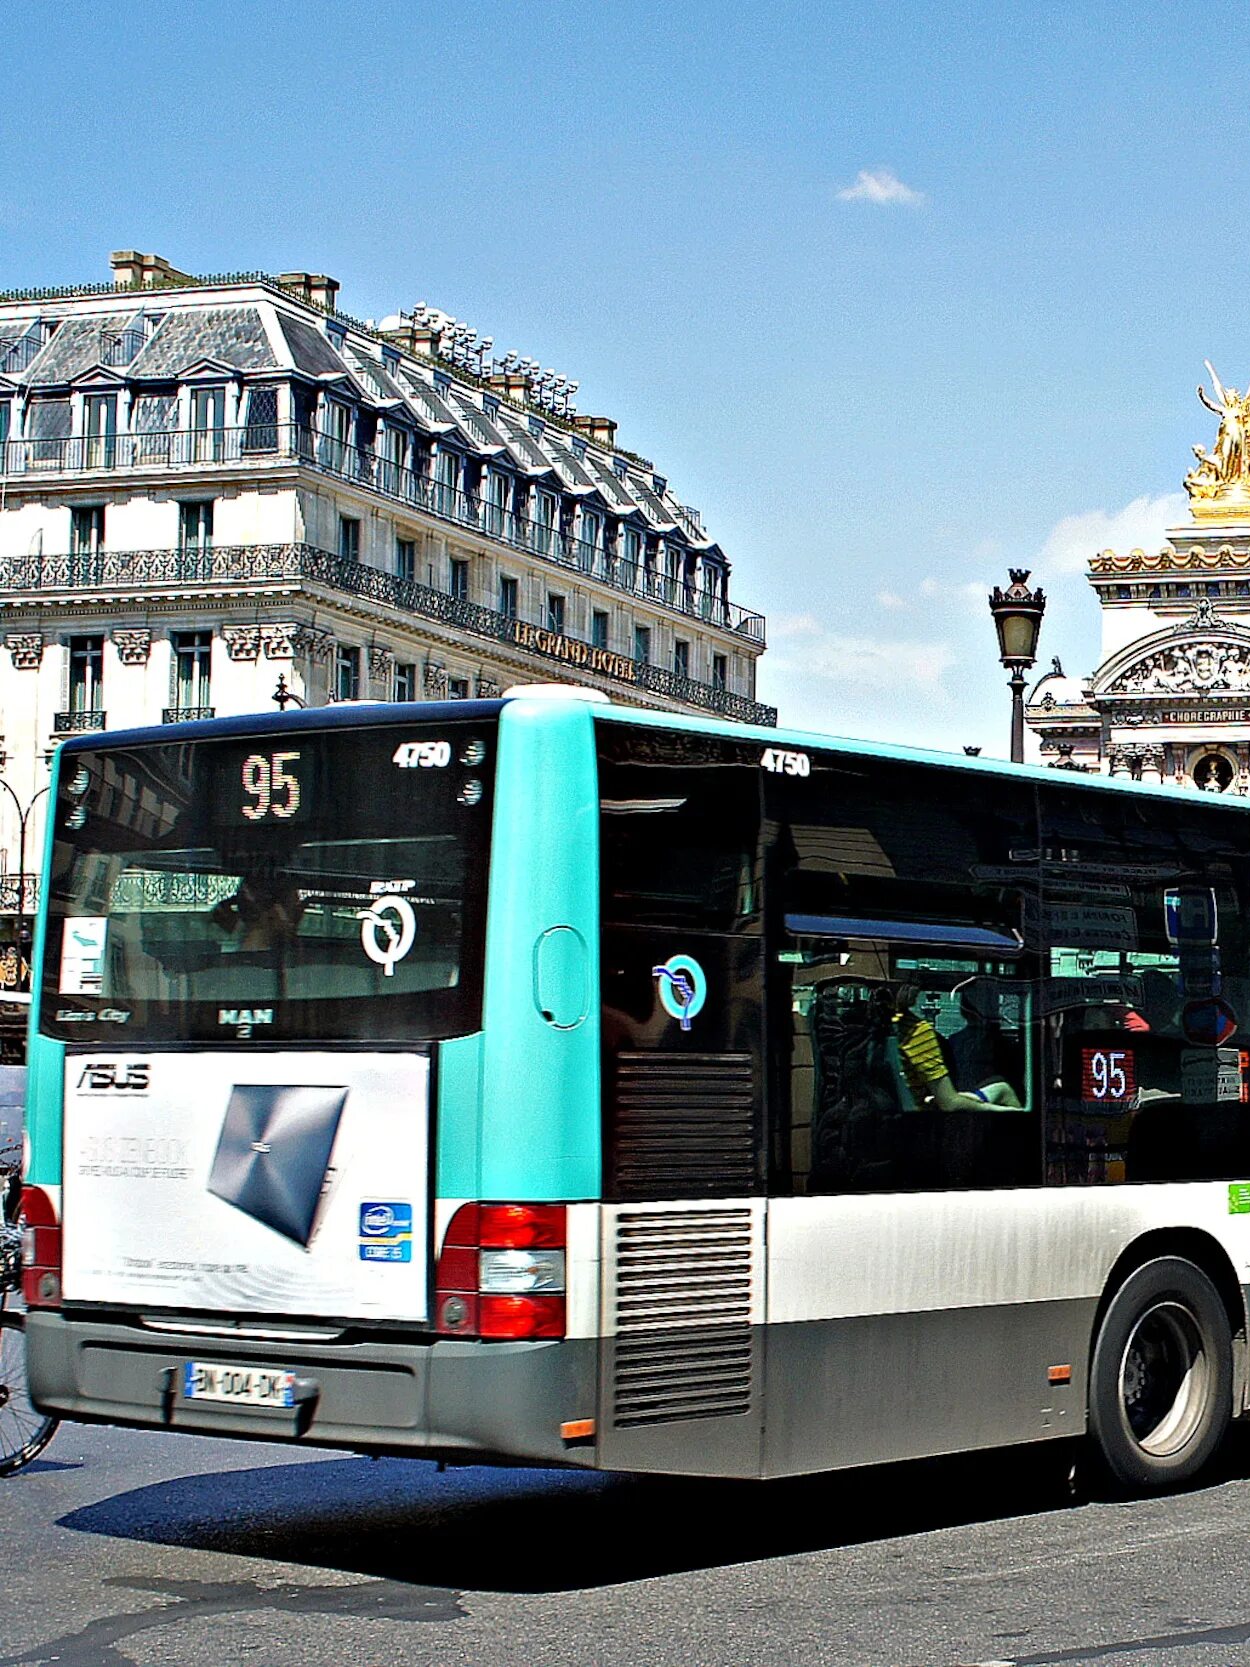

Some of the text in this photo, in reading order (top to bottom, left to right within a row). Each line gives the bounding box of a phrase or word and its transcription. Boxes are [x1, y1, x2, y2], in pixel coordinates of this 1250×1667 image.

[514, 621, 637, 680] LE GRAND HOTEL
[1169, 709, 1246, 722] CHOREGRAPHIE
[392, 741, 451, 768] 4750
[760, 748, 810, 777] 4750
[241, 751, 300, 820] 95
[218, 1008, 273, 1024] MAN
[76, 1064, 151, 1089] ASUS
[1092, 1052, 1126, 1098] 95
